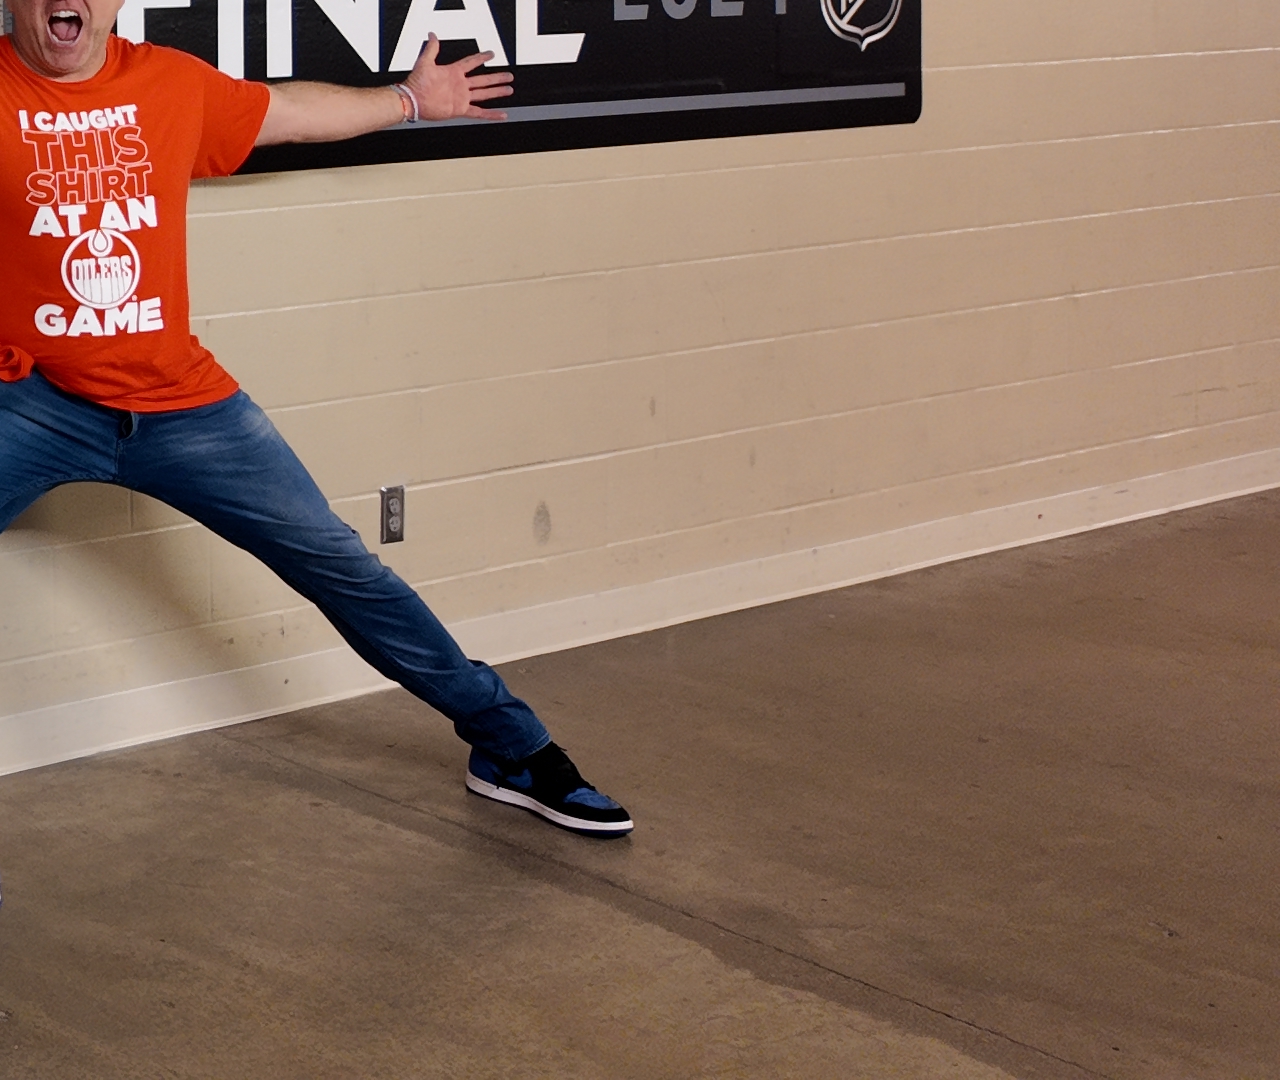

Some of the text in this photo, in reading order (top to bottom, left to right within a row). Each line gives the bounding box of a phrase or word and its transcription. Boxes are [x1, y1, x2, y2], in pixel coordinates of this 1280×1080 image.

[18, 104, 137, 131] I CAUGHT
[22, 124, 148, 171] THIS
[26, 161, 153, 205] SHIRT
[29, 195, 158, 238] AT AN
[71, 254, 133, 301] OILERS
[34, 296, 164, 337] GAME
